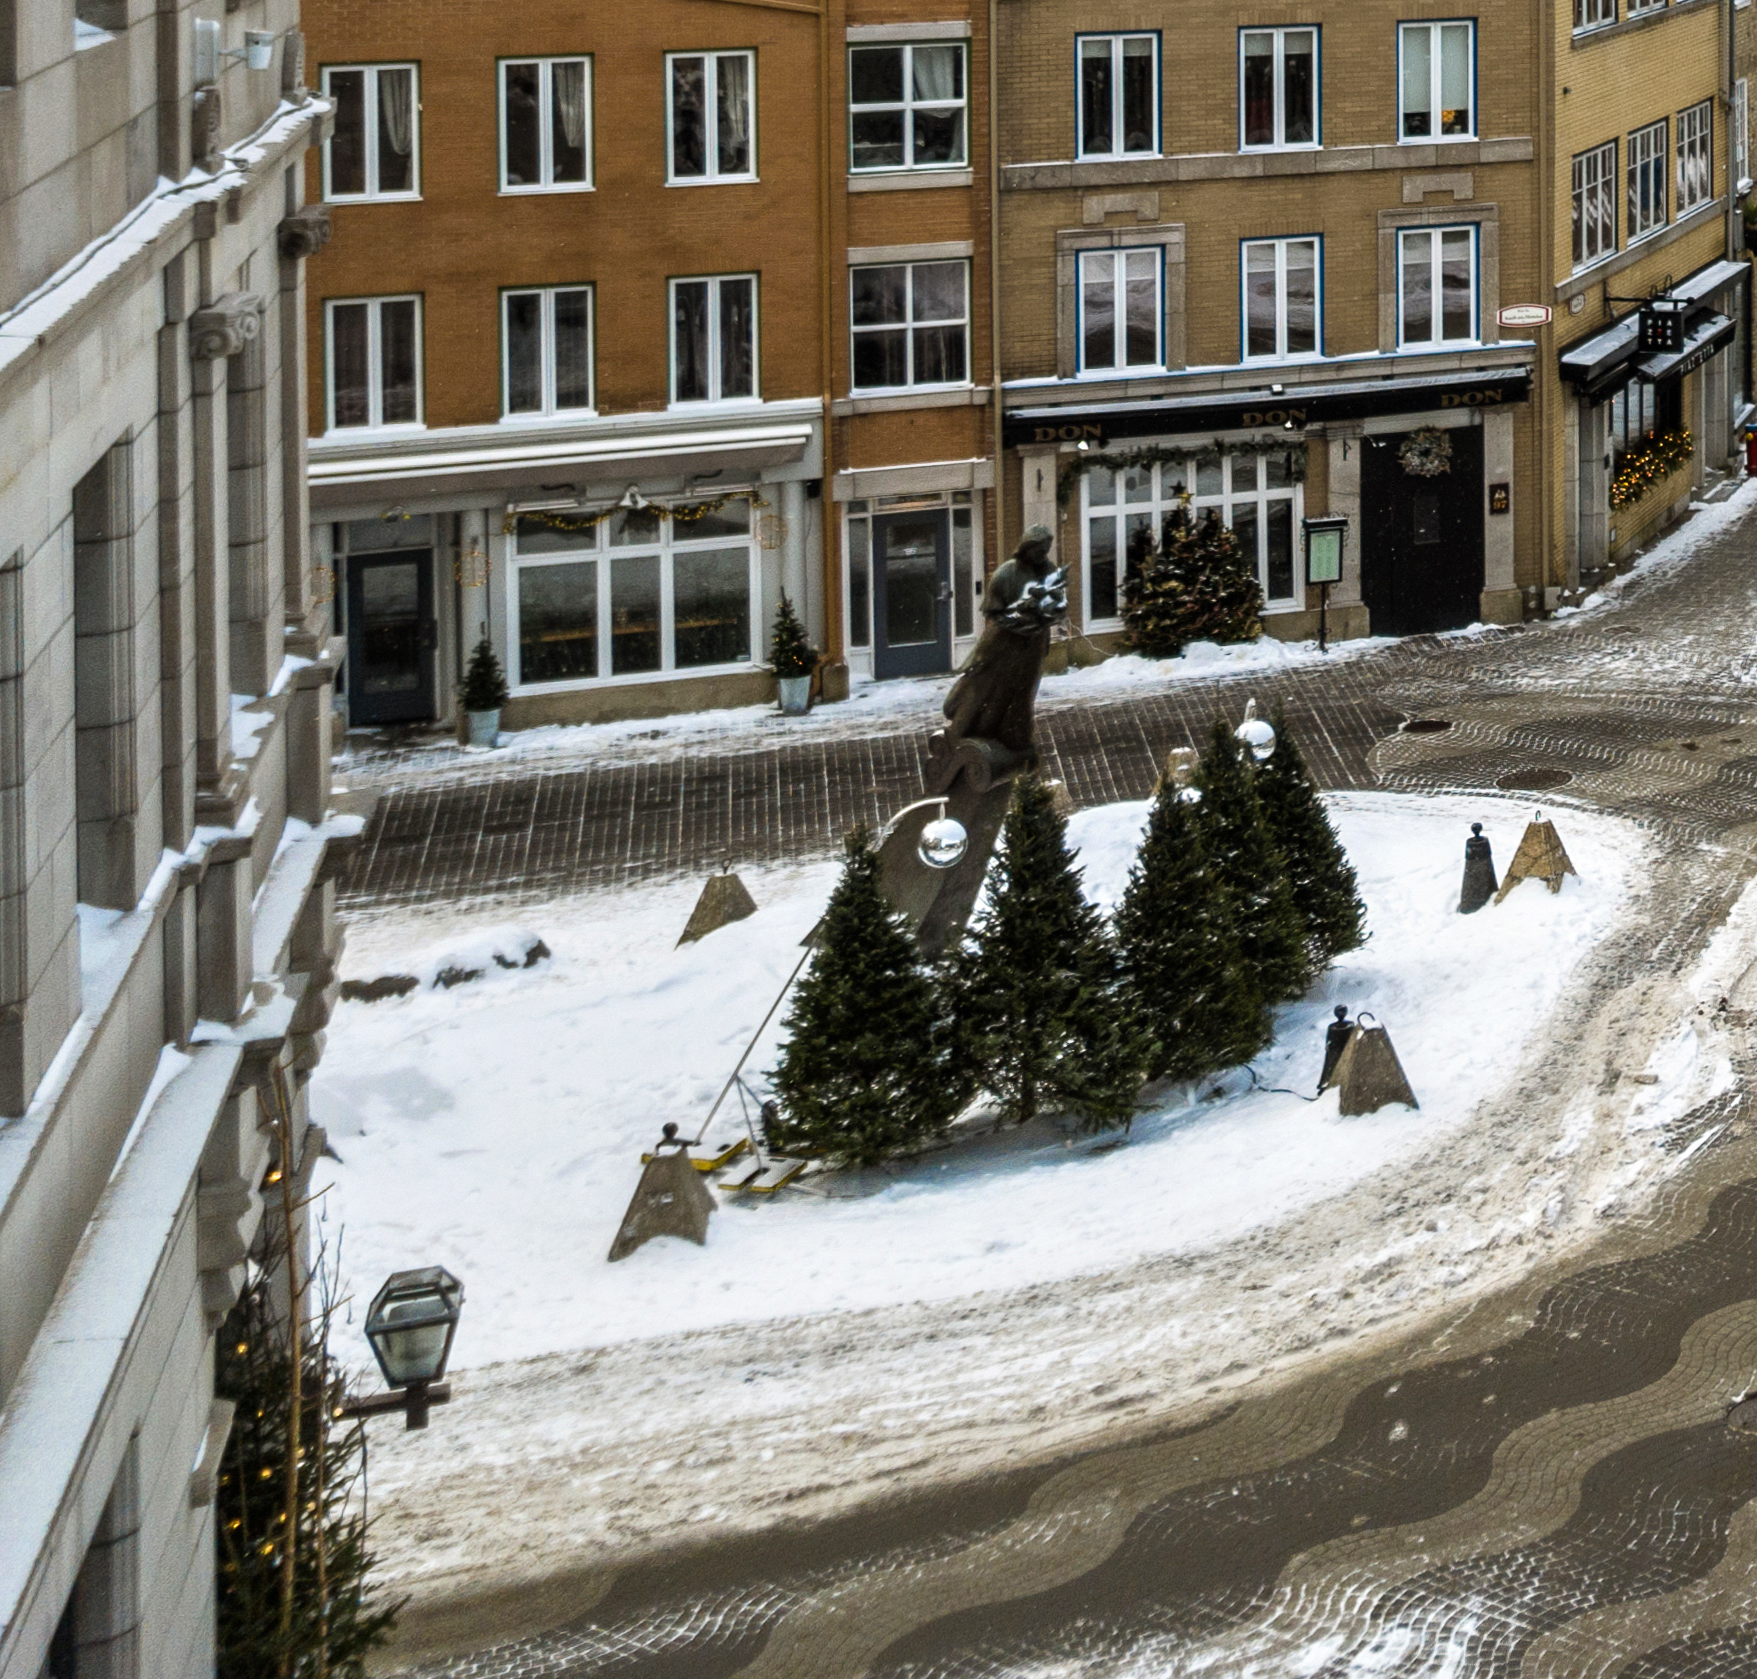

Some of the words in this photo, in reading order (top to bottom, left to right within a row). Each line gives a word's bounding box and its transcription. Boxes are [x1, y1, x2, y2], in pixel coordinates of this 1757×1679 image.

[1441, 388, 1504, 408] DON
[1242, 409, 1307, 427] DON
[1035, 424, 1103, 442] DON
